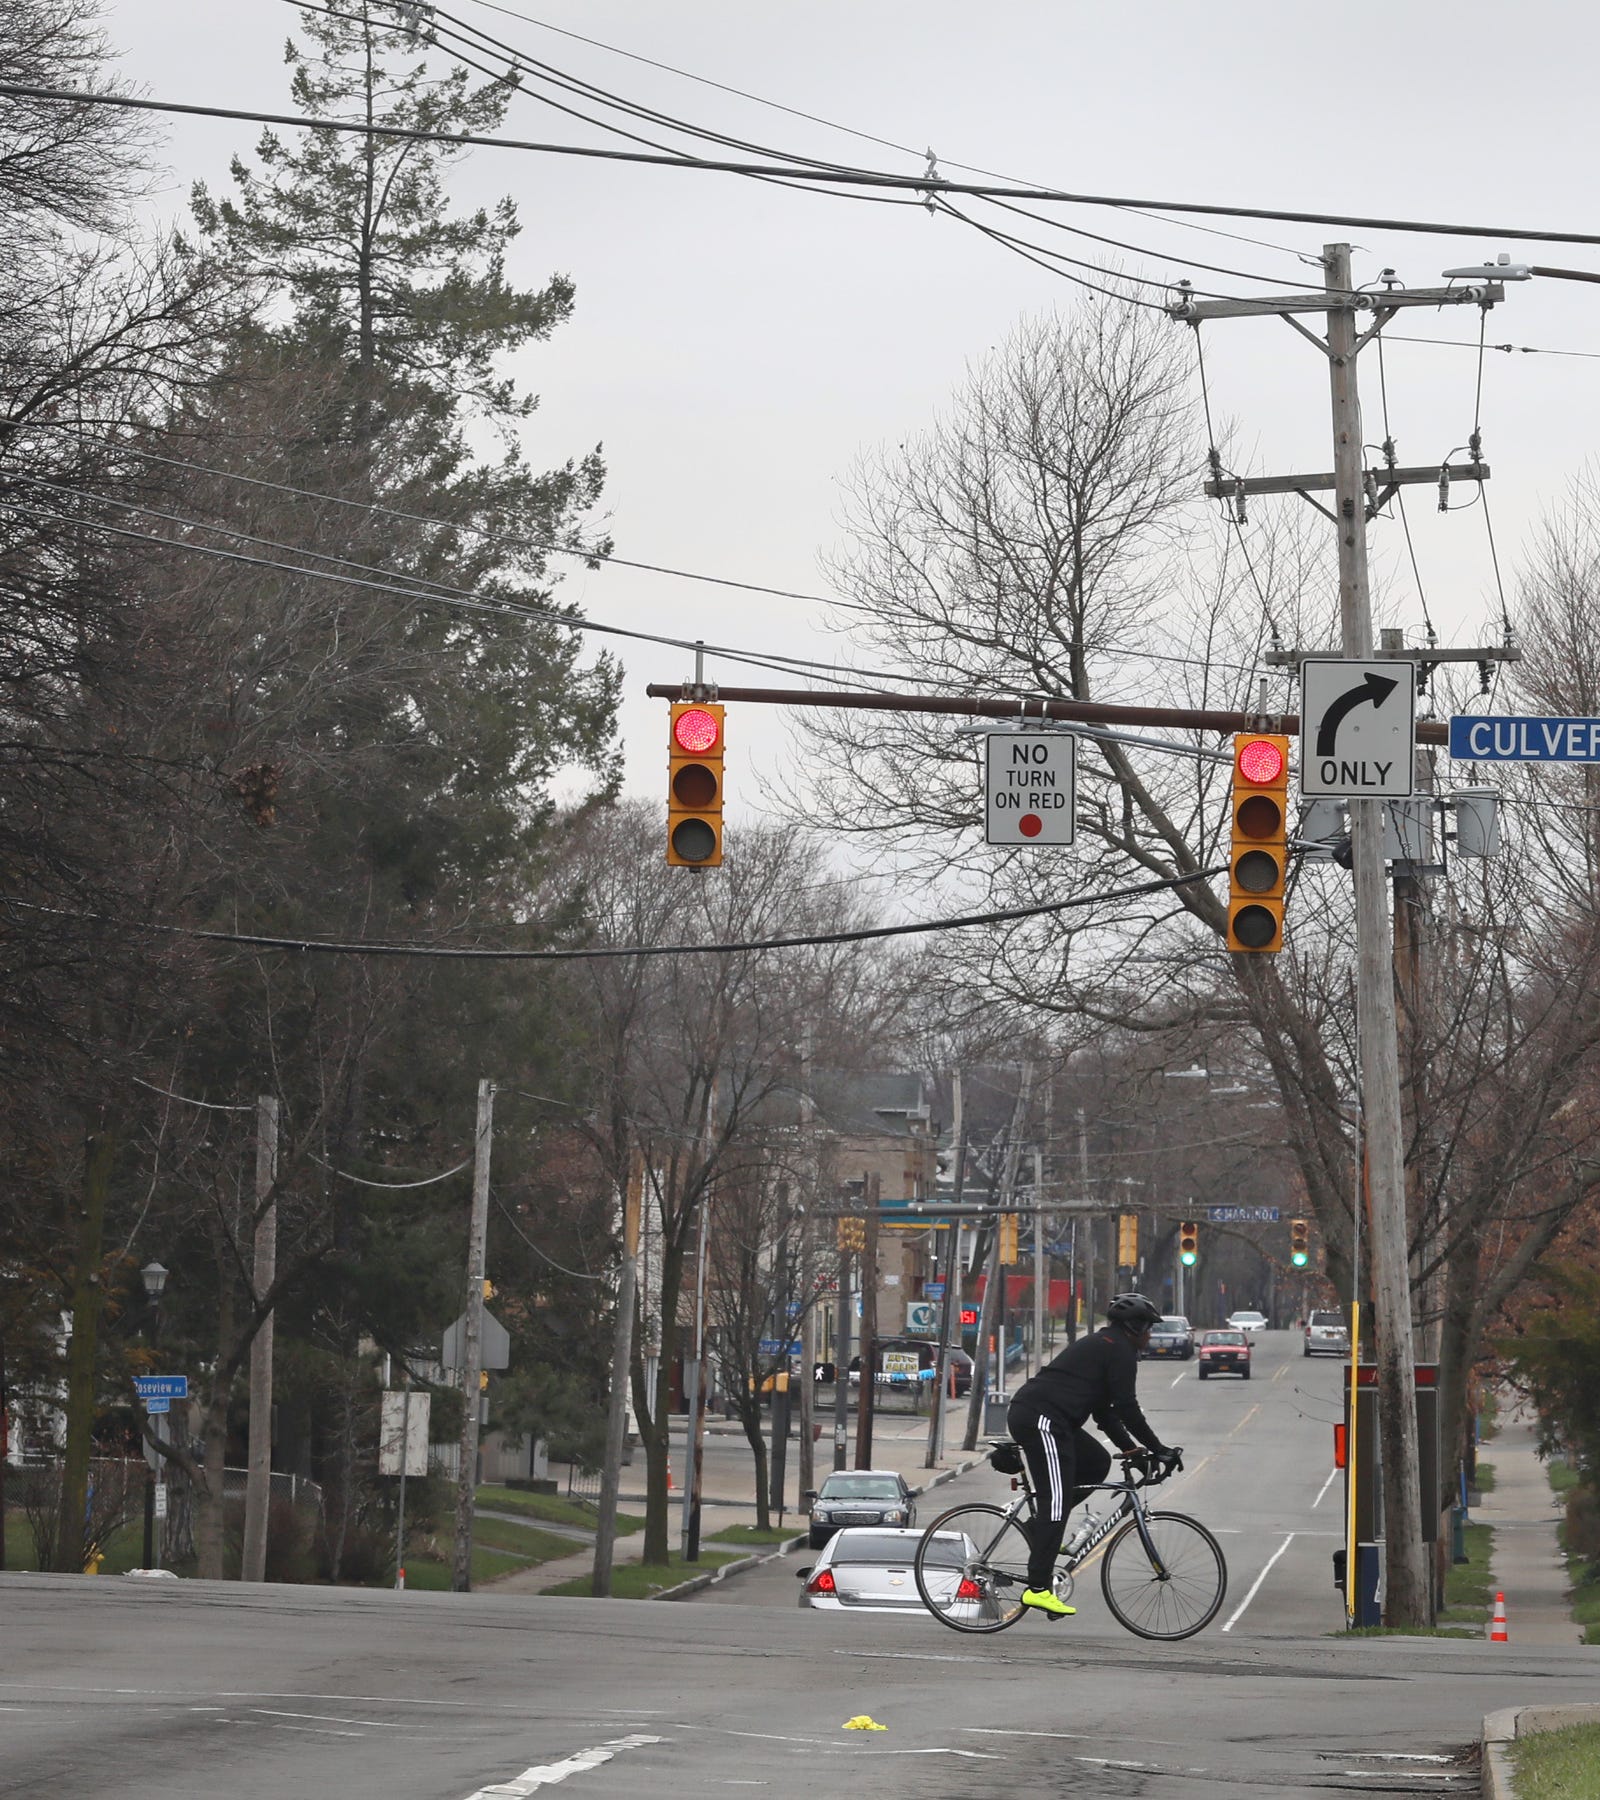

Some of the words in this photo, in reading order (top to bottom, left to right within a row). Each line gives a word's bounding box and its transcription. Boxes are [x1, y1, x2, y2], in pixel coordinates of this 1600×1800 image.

[1012, 743, 1049, 765] NO
[1005, 770, 1056, 787] TURN
[1320, 760, 1393, 786] ONLY
[995, 791, 1021, 810] ON
[1029, 792, 1066, 809] RED
